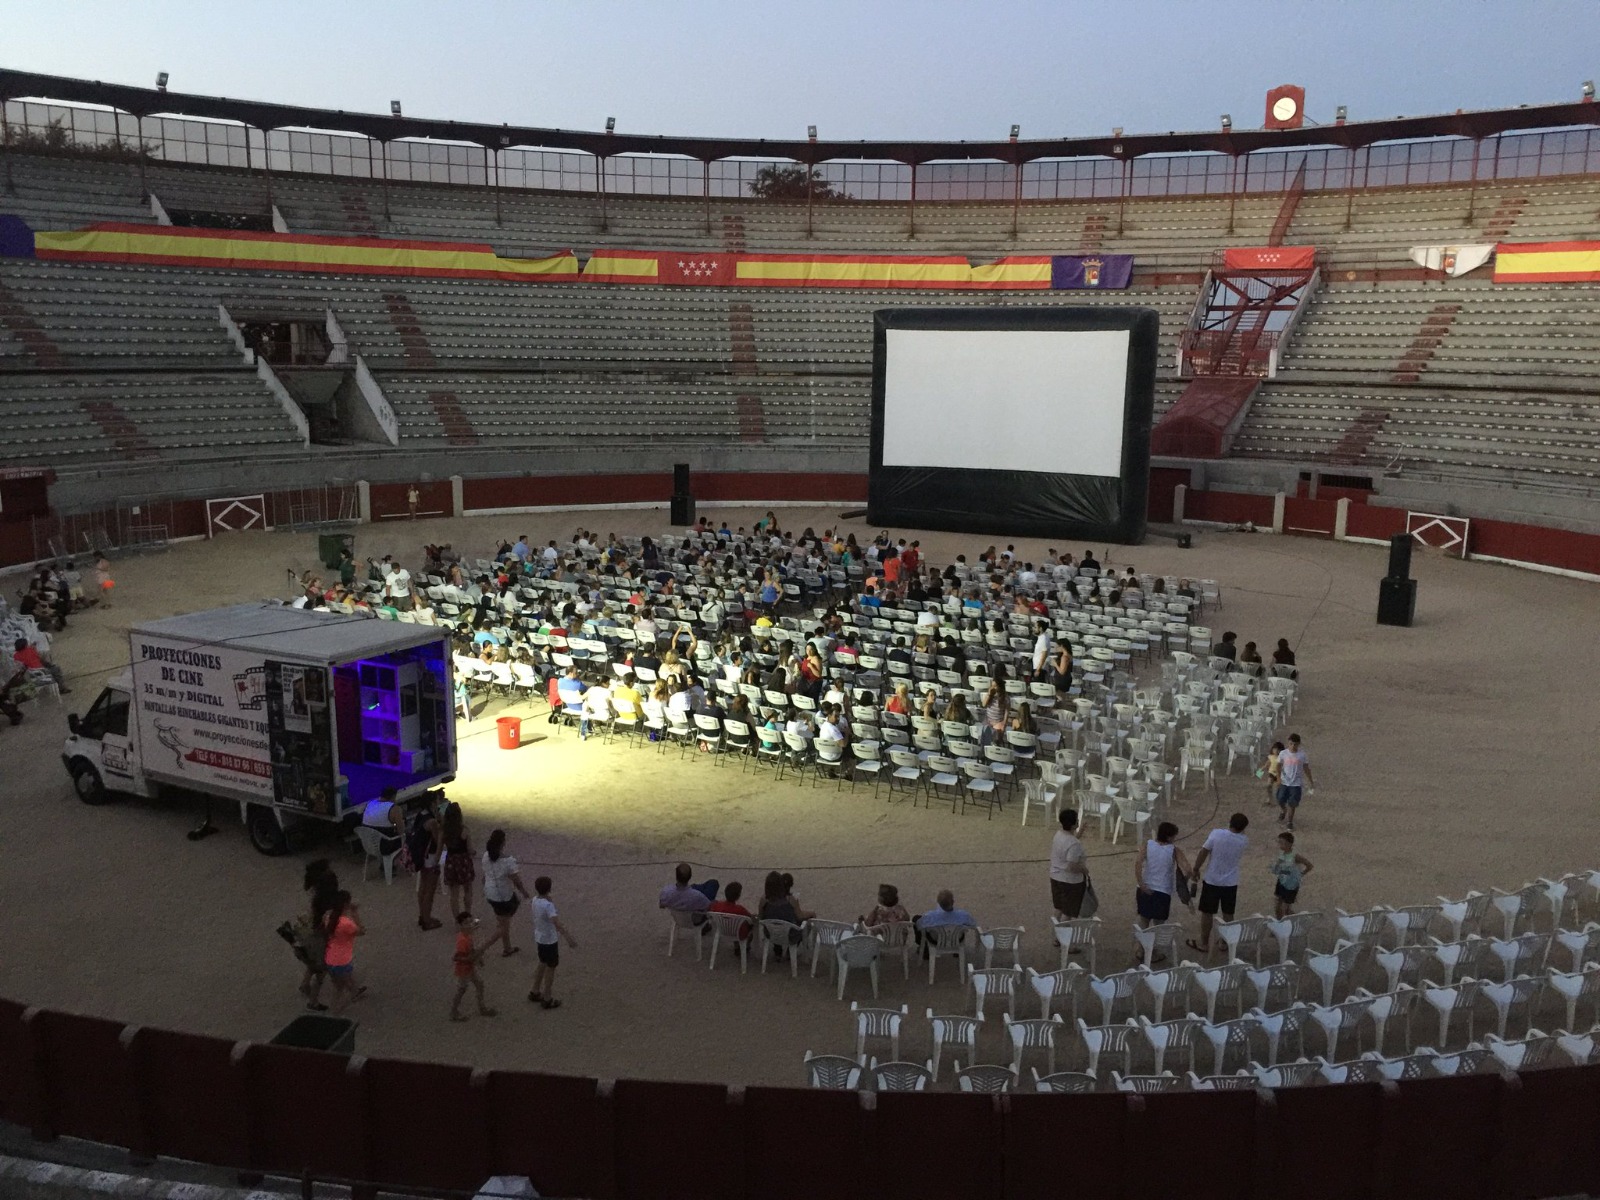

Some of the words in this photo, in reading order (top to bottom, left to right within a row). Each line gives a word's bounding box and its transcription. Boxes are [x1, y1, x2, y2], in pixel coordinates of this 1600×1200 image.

[141, 644, 222, 670] PROYECCIONES
[161, 666, 176, 681] DE
[178, 669, 204, 687] CINE
[144, 683, 153, 694] 35
[156, 687, 177, 698] m/m
[179, 691, 185, 701] y
[187, 691, 225, 707] DIGITAL
[144, 701, 176, 715] PANTALLAS
[177, 706, 217, 724] HINCHABLES
[217, 714, 248, 730] GIGANTES
[249, 720, 255, 731] Y
[210, 753, 217, 764] 91
[213, 772, 238, 783] UNIDAD
